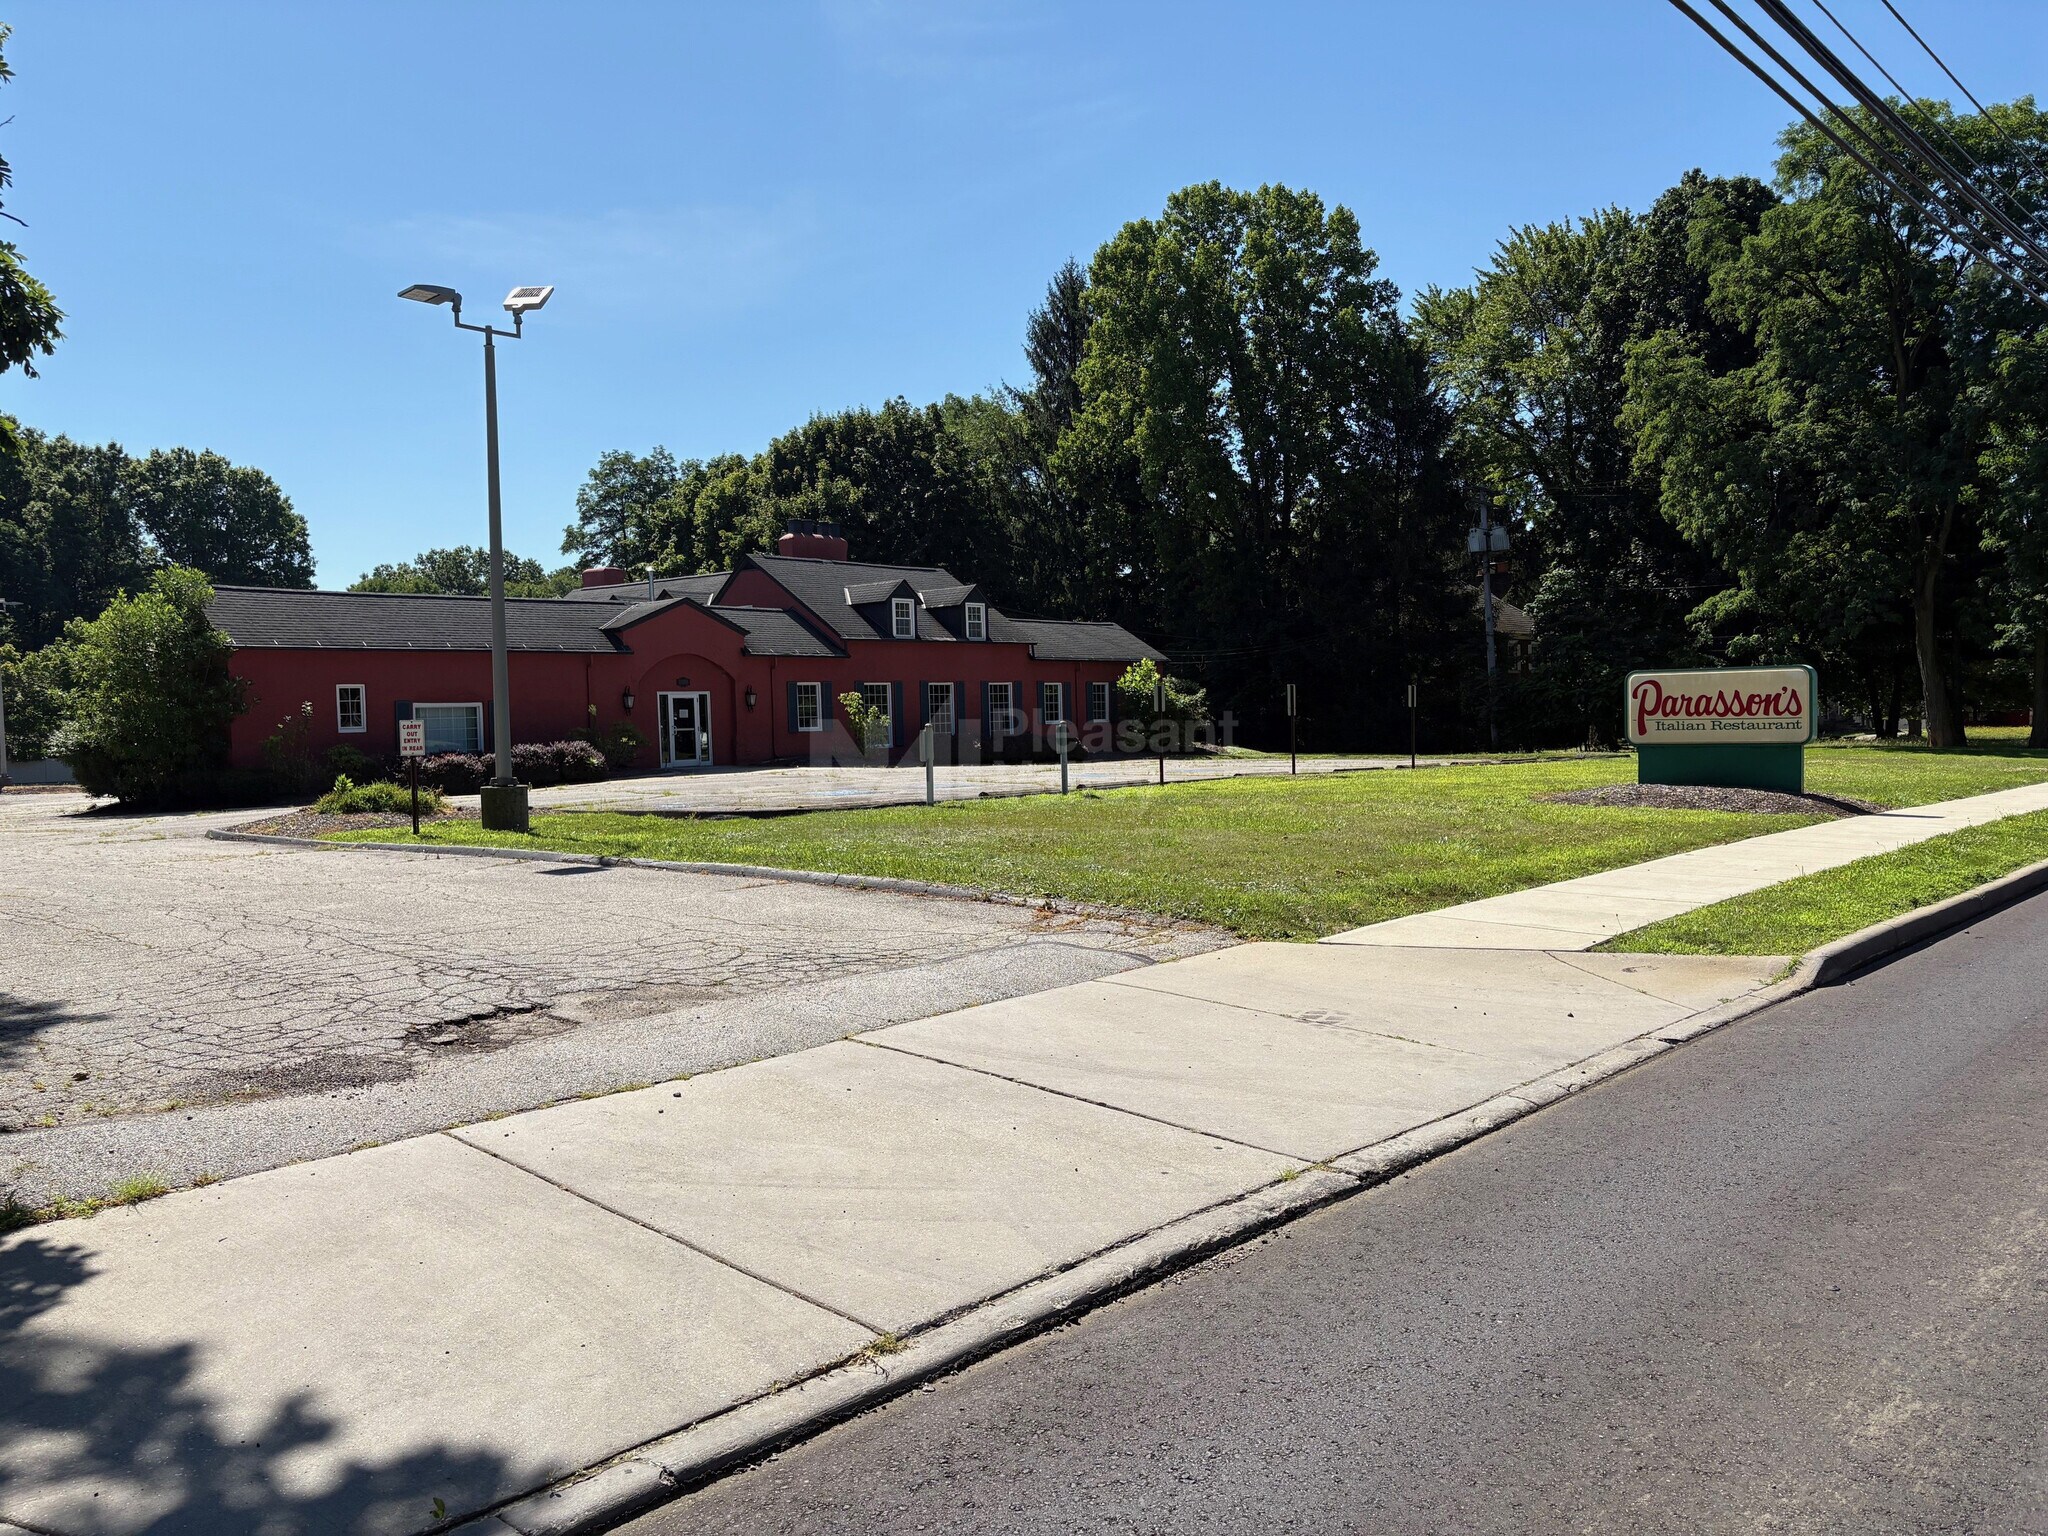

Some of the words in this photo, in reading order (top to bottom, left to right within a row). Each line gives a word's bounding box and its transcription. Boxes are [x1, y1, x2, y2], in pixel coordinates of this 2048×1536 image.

[1632, 680, 1802, 736] Parasson's
[1655, 720, 1706, 731] Italian
[1710, 719, 1802, 731] Restaurant
